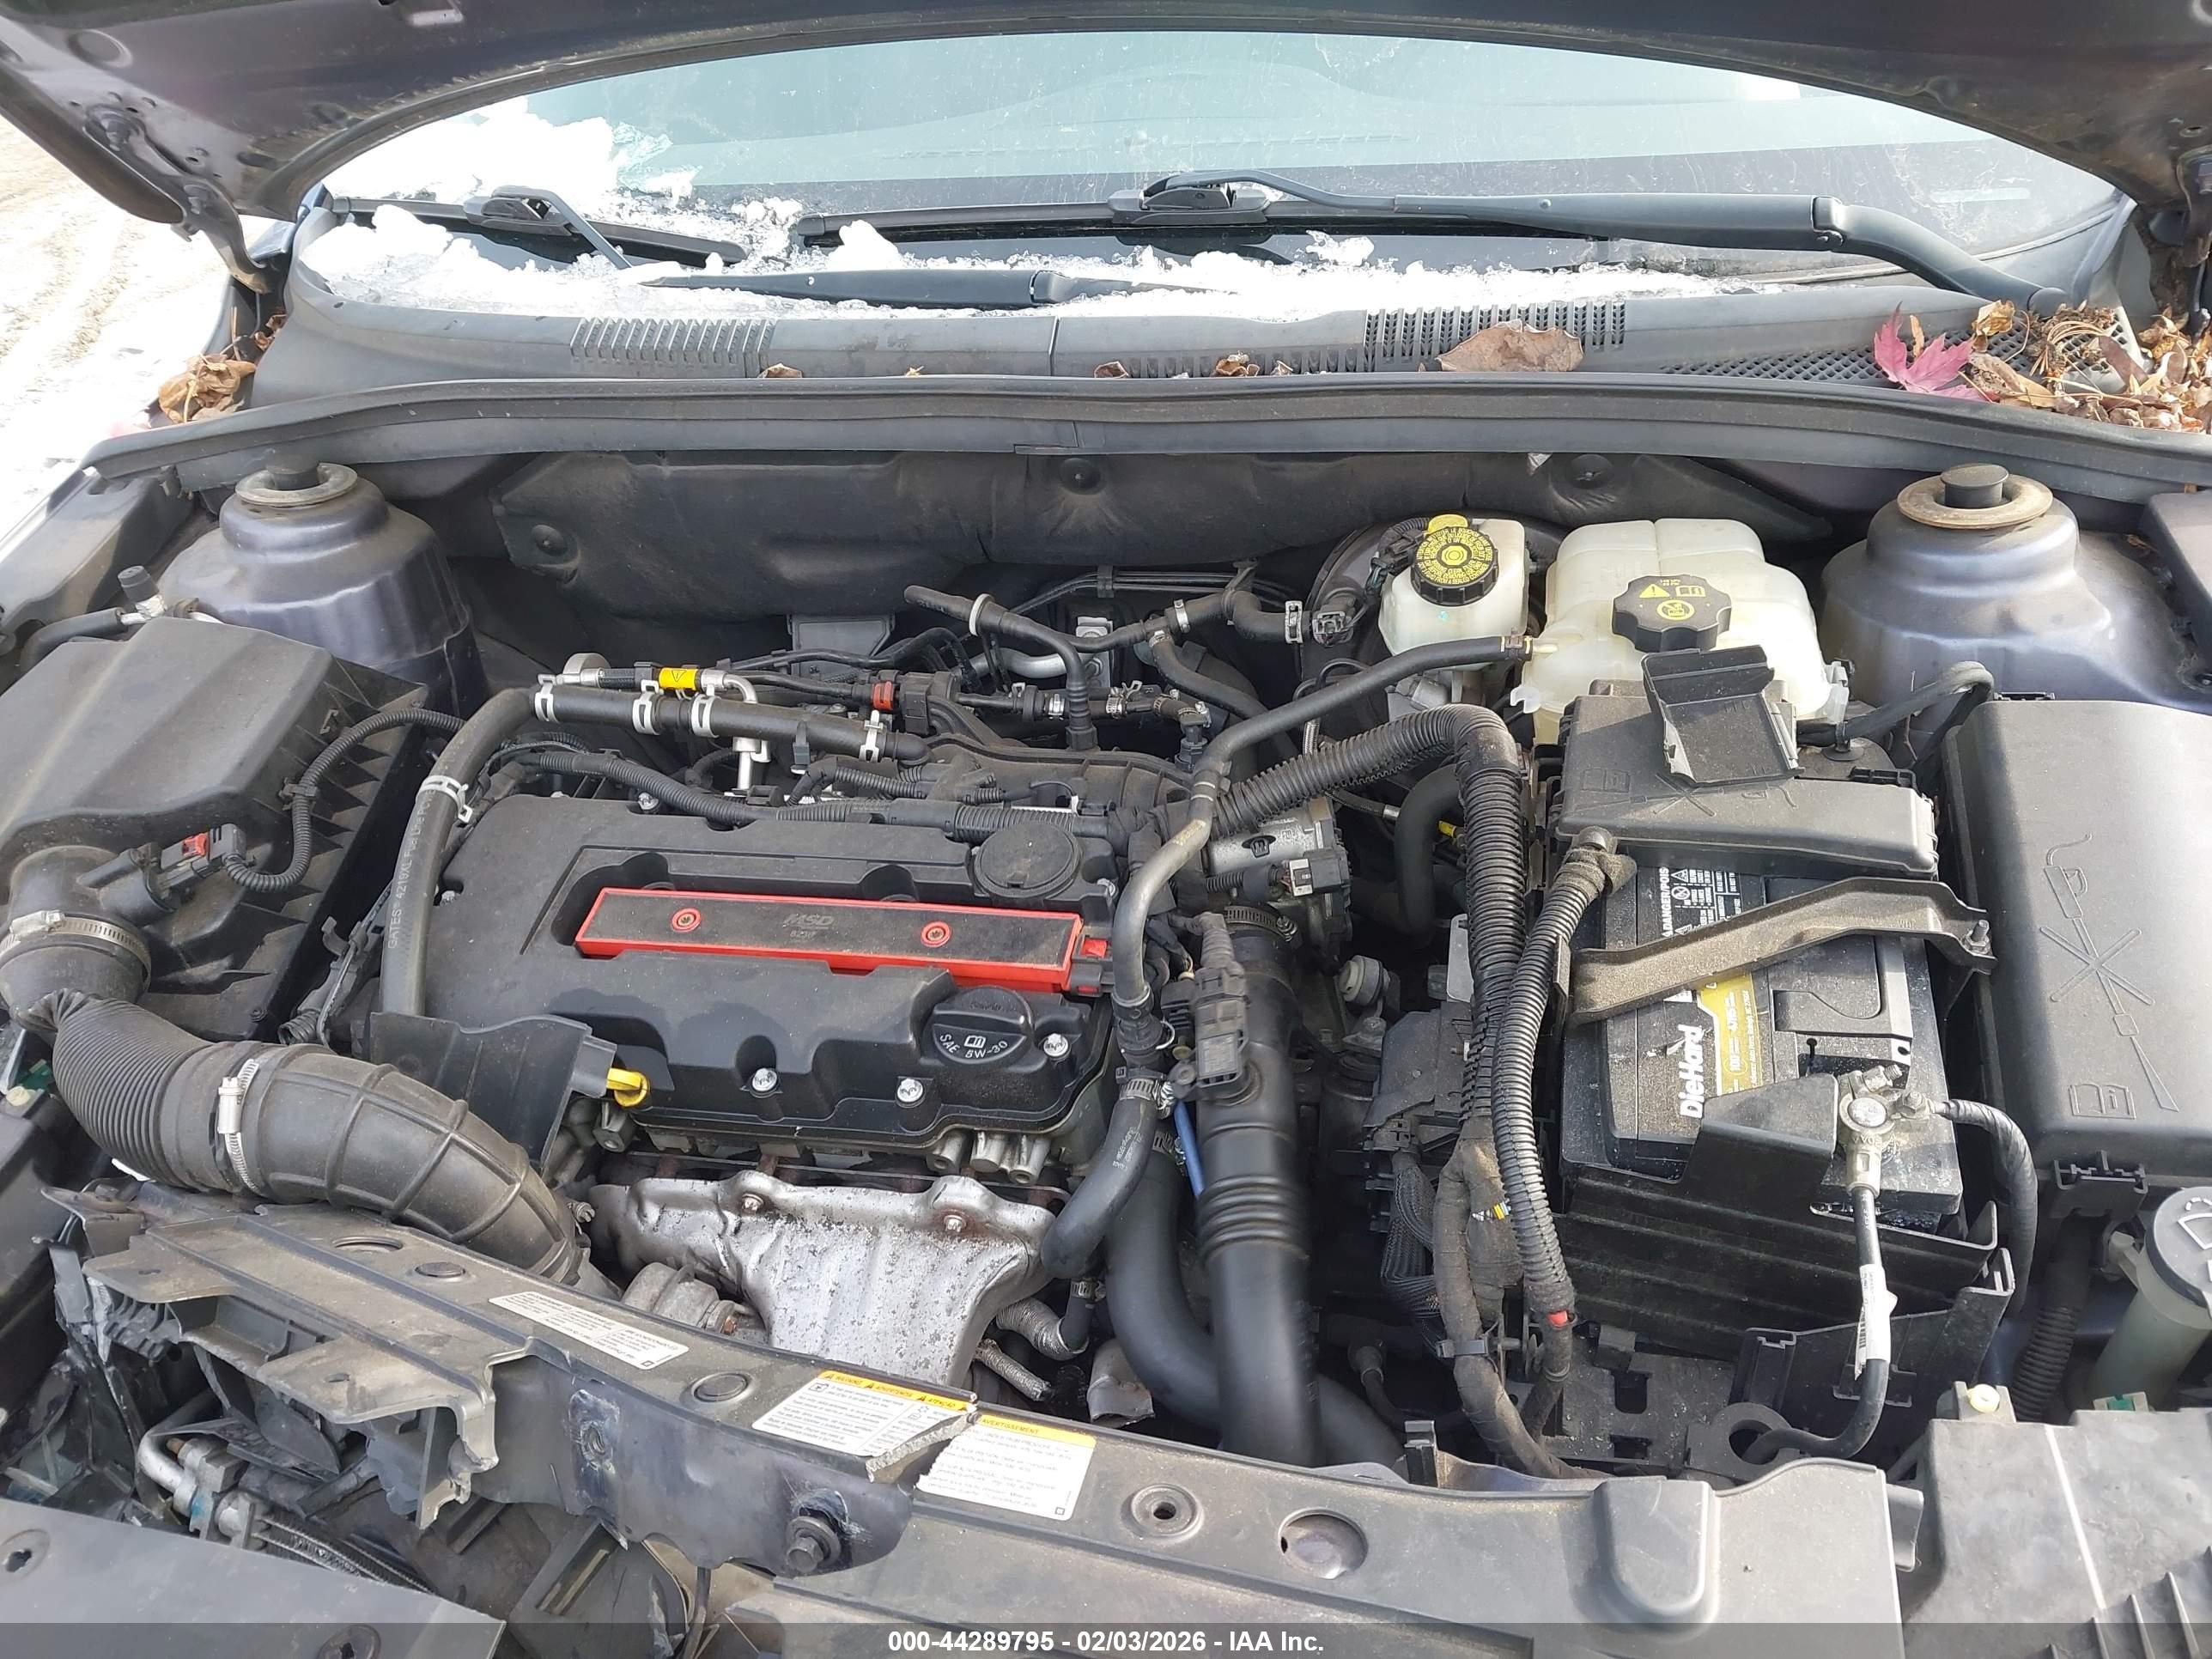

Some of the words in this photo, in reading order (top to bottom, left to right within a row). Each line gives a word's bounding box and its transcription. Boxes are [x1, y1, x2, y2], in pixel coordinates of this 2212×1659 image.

[939, 1034, 961, 1054] SAE
[964, 1040, 1008, 1059] 5W-30
[1678, 1024, 1705, 1119] DieHard
